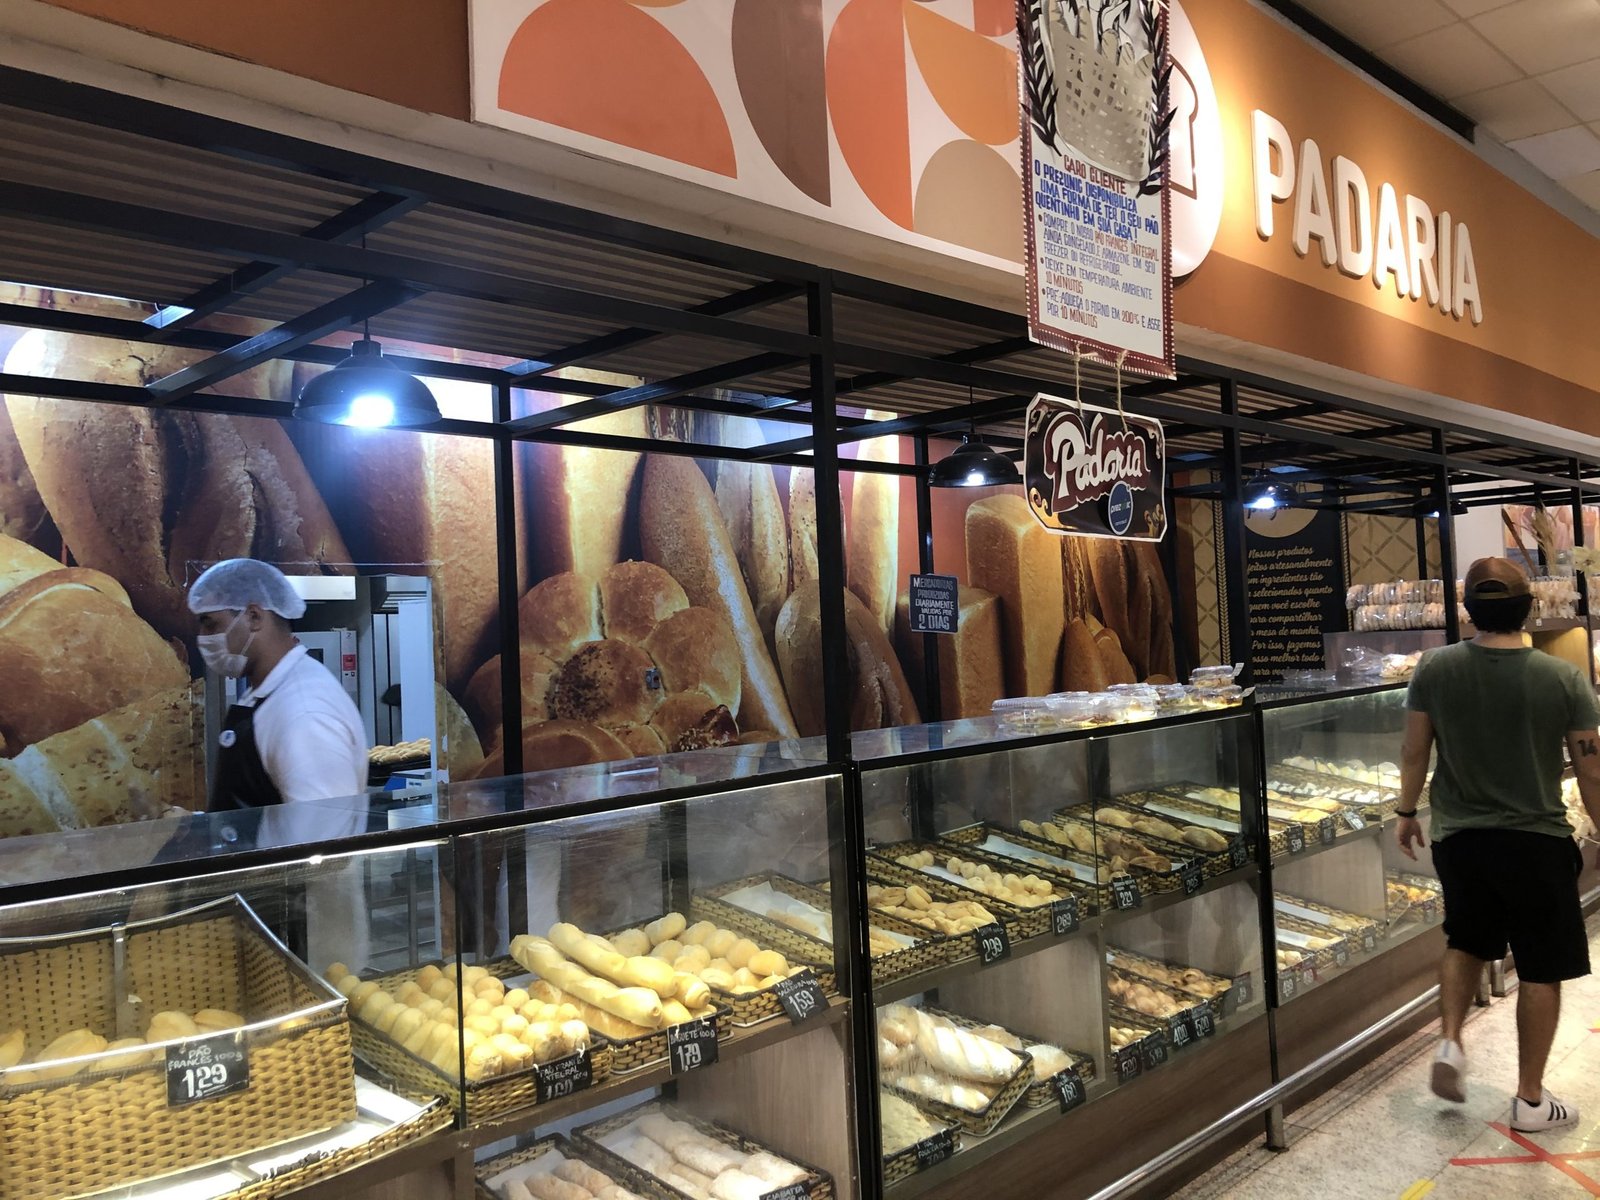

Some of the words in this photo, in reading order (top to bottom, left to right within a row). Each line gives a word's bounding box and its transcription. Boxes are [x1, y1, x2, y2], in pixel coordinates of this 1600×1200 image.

[1064, 154, 1086, 179] CARO
[1090, 166, 1126, 195] CLIENTE
[1034, 159, 1040, 175] O
[1085, 181, 1138, 213] DISPONIBILIZA
[1035, 191, 1080, 221] QUENTINHO
[1082, 210, 1095, 227] EM
[1097, 215, 1112, 235] SUA
[1114, 221, 1132, 240] CASA
[1040, 178, 1060, 198] UMA
[1062, 187, 1091, 211] FORMA
[1093, 199, 1102, 216] DE
[1104, 204, 1117, 221] TER
[1120, 210, 1126, 223] O
[1128, 212, 1142, 229] SEU
[1145, 214, 1159, 235] PÃO
[1251, 109, 1483, 324] PADARIA
[1043, 211, 1068, 233] COMPRE
[1071, 221, 1075, 234] O
[1130, 242, 1159, 261] INTEGRAL
[1043, 241, 1069, 260] FREEZER
[1043, 228, 1062, 245] AINDA
[1063, 233, 1095, 255] CONGELADO
[1102, 247, 1130, 266] ARMAZENE
[1132, 256, 1141, 269] EM
[1145, 260, 1155, 275] SEU
[1045, 256, 1065, 276] DEIXE
[1066, 264, 1076, 277] EM
[1078, 266, 1120, 291] TEMPERATURA
[1121, 281, 1152, 300] AMBIENTE
[1053, 273, 1083, 295] MINUTOS
[1047, 301, 1059, 318] POR
[1060, 305, 1068, 320] 10
[1069, 308, 1098, 329] MINUTOS
[1085, 298, 1089, 312] O
[1090, 300, 1110, 318] FORNO
[1111, 307, 1120, 320] EM
[1141, 315, 1146, 328] E
[1147, 317, 1161, 331] ASSE
[1051, 420, 1143, 499] Padaria
[1276, 546, 1313, 559] produtos
[1269, 558, 1333, 570] artesanalmente
[1260, 573, 1308, 587] ingredientes
[1309, 572, 1324, 580] tão
[1252, 586, 1302, 598] selecionados
[1304, 585, 1333, 597] quanto
[915, 598, 954, 610] DIARIAMENTE
[1271, 600, 1289, 609] você
[1290, 598, 1320, 609] escolhe
[918, 614, 926, 629] 2
[928, 615, 950, 630] DIAS
[1268, 611, 1323, 625] compartilhar
[1278, 626, 1289, 636] de
[1252, 640, 1266, 650] Por
[1286, 641, 1321, 652] fazemos
[1270, 653, 1300, 662] melhor
[1301, 652, 1320, 662] todo
[181, 1063, 228, 1098] 1,29
